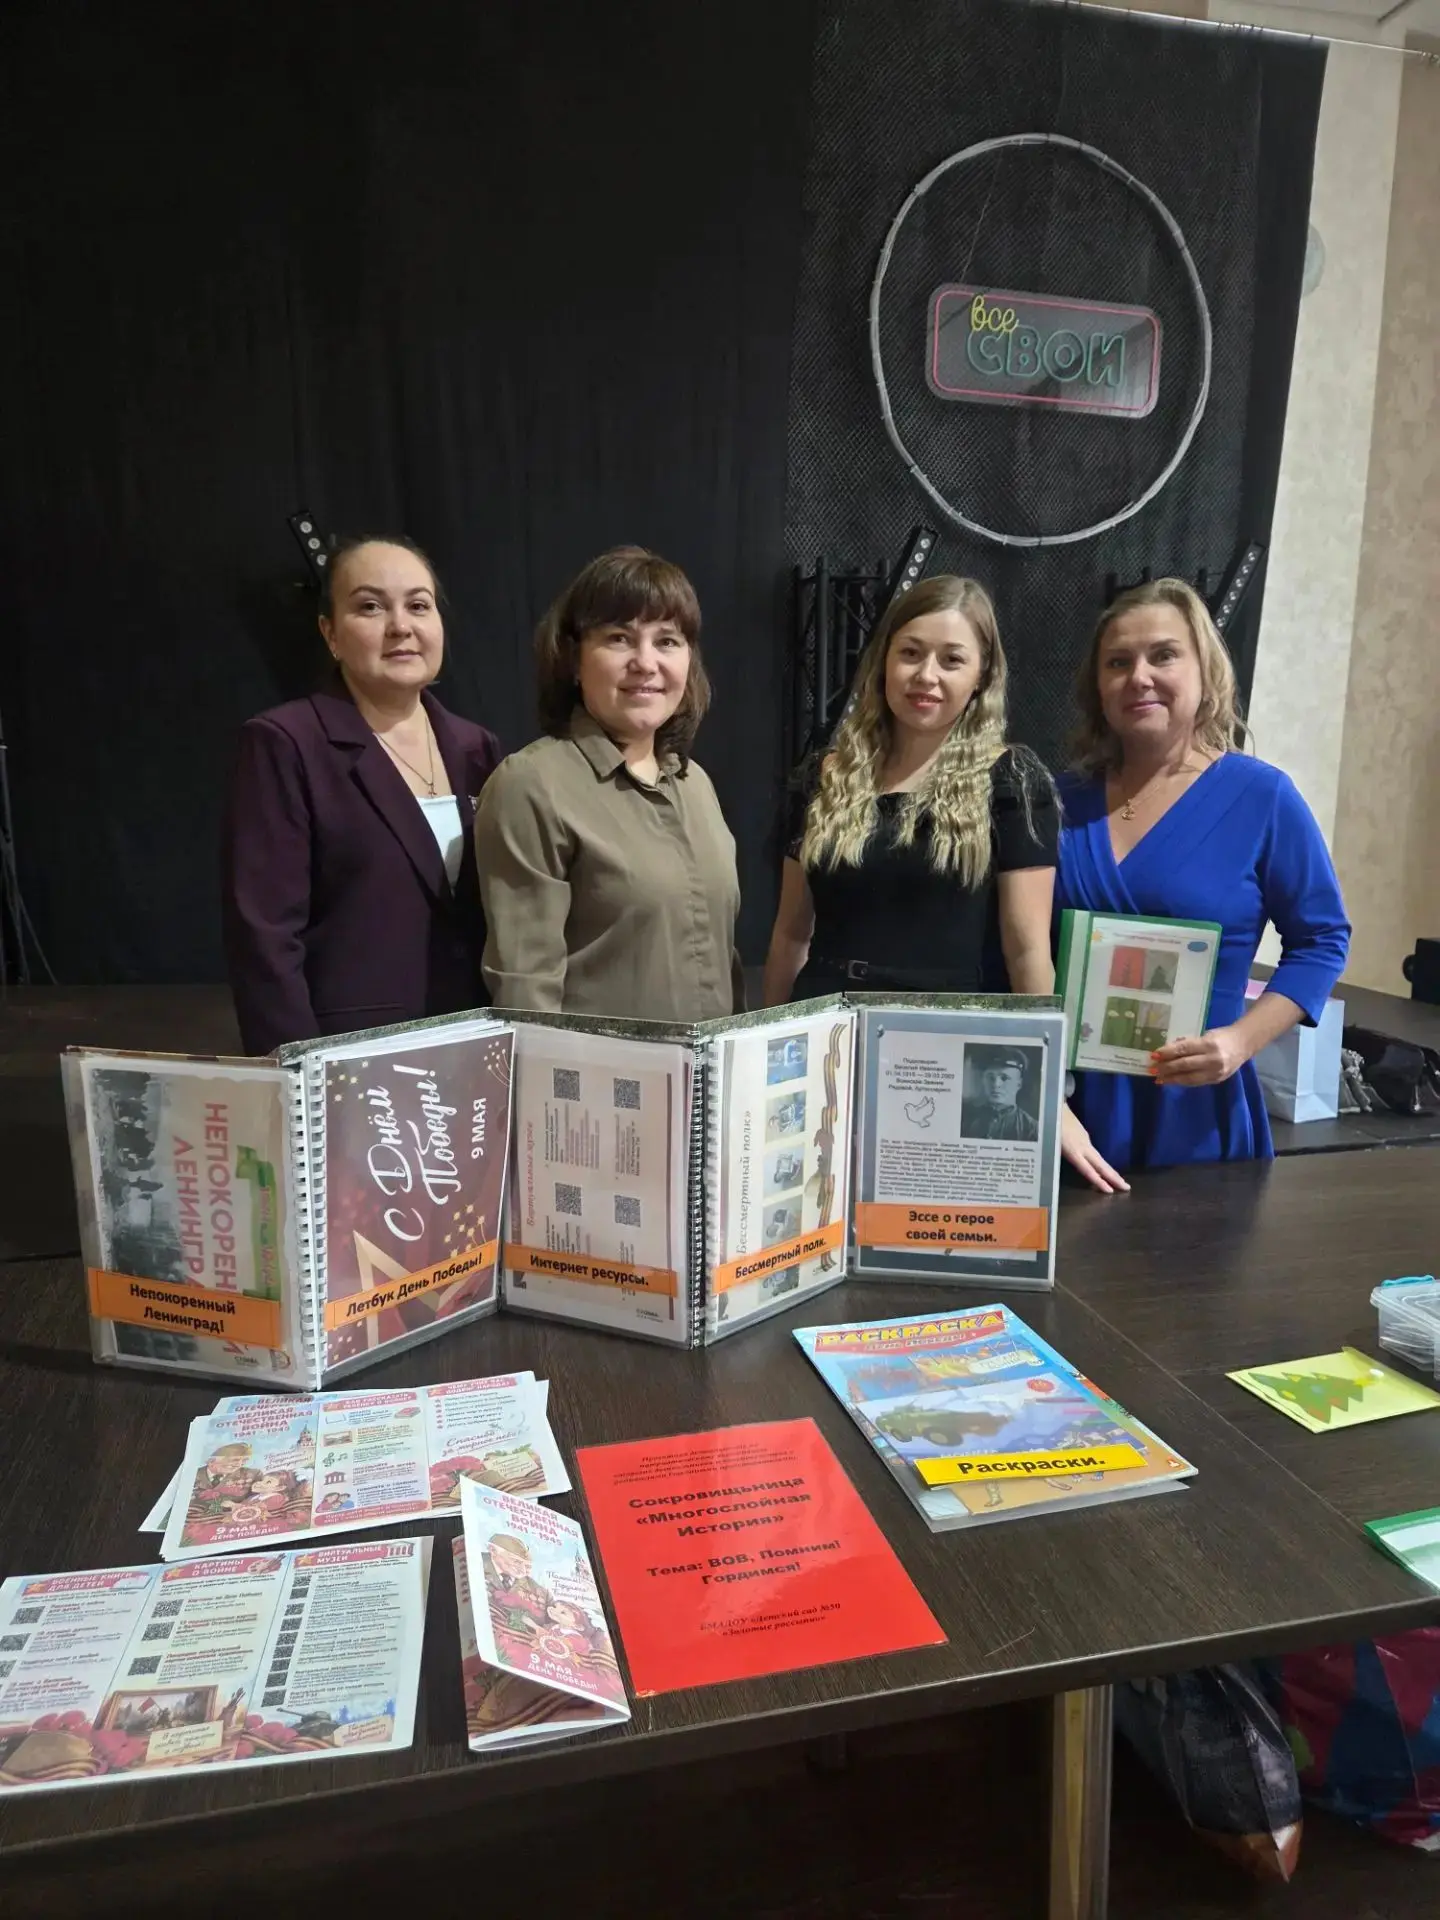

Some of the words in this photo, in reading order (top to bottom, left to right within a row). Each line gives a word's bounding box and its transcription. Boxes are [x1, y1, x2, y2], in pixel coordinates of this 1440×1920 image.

[971, 295, 1019, 332] все
[967, 324, 1125, 387] СВОИ
[471, 1097, 487, 1142] МАЯ
[366, 1084, 413, 1196] Днём
[392, 1064, 462, 1206] Победы!
[471, 1148, 484, 1160] 9
[384, 1207, 425, 1241] С
[909, 1211, 939, 1222] Эссе
[943, 1214, 951, 1222] о
[955, 1214, 994, 1226] герое
[906, 1229, 946, 1241] своей
[950, 1231, 997, 1242] семьи.
[530, 1252, 588, 1275] Интернет
[592, 1265, 649, 1286] ресурсы.
[735, 1244, 801, 1278] Бессмертный
[803, 1238, 826, 1254] полк.
[346, 1291, 394, 1317] Летбук
[397, 1279, 430, 1300] День
[433, 1253, 482, 1284] Победы!
[130, 1284, 237, 1315] Непокоренный
[144, 1306, 225, 1333] Ленинград!
[822, 1315, 1002, 1345] РАСКРАСКА
[215, 1411, 312, 1428] ОТЕЧЕСТВЕННАЯ
[238, 1407, 294, 1420] ВЕЛИКАЯ
[242, 1420, 288, 1432] ВОЙНА
[957, 1455, 1106, 1475] Раскраски.
[483, 1497, 579, 1538] ОТЕЧЕСТВЕННАЯ
[502, 1494, 558, 1521] ВЕЛИКАЯ
[636, 1494, 812, 1525] «Многослойная
[209, 1533, 234, 1541] ДЕНЬ
[216, 1527, 226, 1535] 9
[229, 1524, 257, 1534] МАЯ
[506, 1521, 528, 1534] 1941
[539, 1532, 562, 1546] 1945
[511, 1514, 558, 1537] ВОЙНА
[676, 1514, 784, 1537] История»
[316, 1555, 348, 1563] МУЗЕИ
[317, 1545, 382, 1558] ВИРТУАЛЬНЫЕ
[646, 1561, 703, 1577] Тема:
[707, 1553, 755, 1569] ВОВ,
[759, 1539, 841, 1560] Помним!
[193, 1559, 244, 1570] КАРТИНЫ
[202, 1566, 238, 1575] ВОЙНЕ
[701, 1562, 802, 1585] Гордимся!
[46, 1583, 70, 1591] ДЛЯ
[71, 1580, 105, 1589] ДЕТЕЙ
[50, 1574, 97, 1585] ВОЕННЫЕ
[99, 1571, 133, 1580] КНИГИ
[801, 1606, 818, 1616] сад
[528, 1663, 552, 1676] ДЕНЬ
[530, 1653, 540, 1664] 9
[545, 1660, 573, 1676] МАЯ
